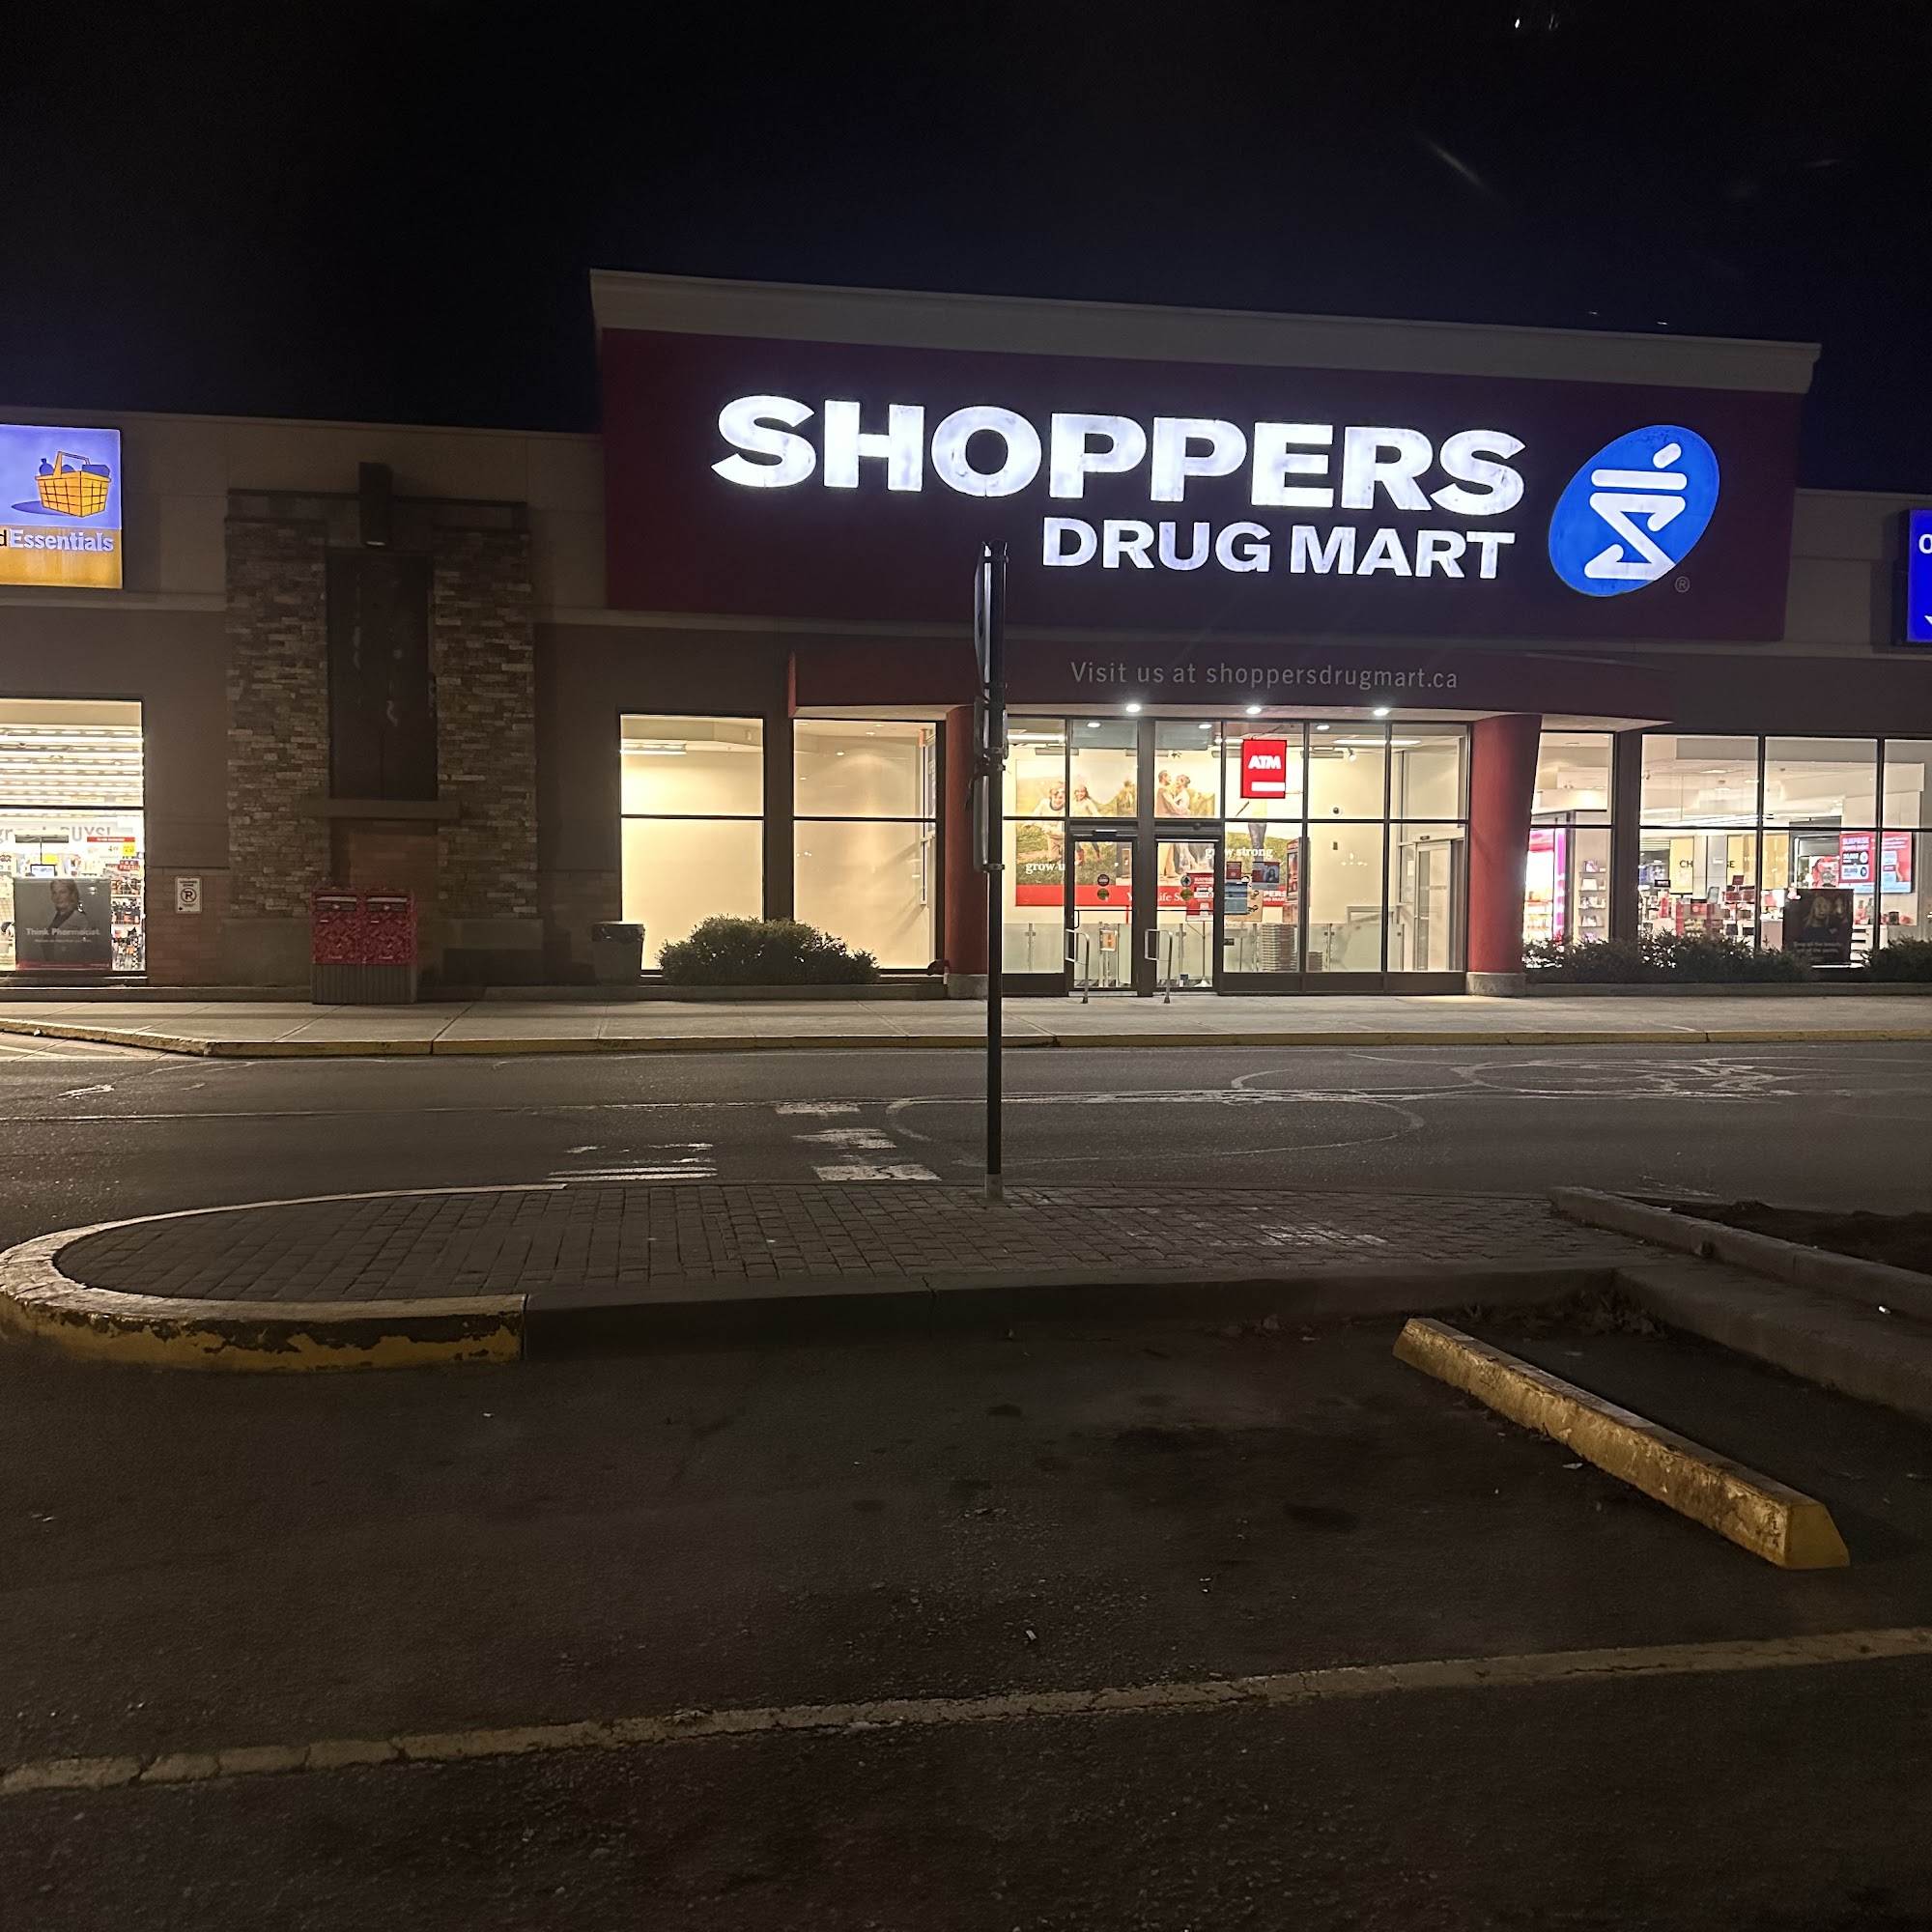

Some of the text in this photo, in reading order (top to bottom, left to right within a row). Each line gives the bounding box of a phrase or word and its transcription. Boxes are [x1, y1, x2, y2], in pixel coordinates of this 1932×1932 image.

[710, 395, 1526, 516] SHOPPERS
[1042, 517, 1516, 580] DRUG MART
[1070, 662, 1458, 691] Visit us at shoppersdrugmart.ca
[1247, 754, 1282, 770] ATM
[1236, 847, 1273, 859] strong
[1025, 862, 1055, 875] grow
[26, 927, 49, 936] Think
